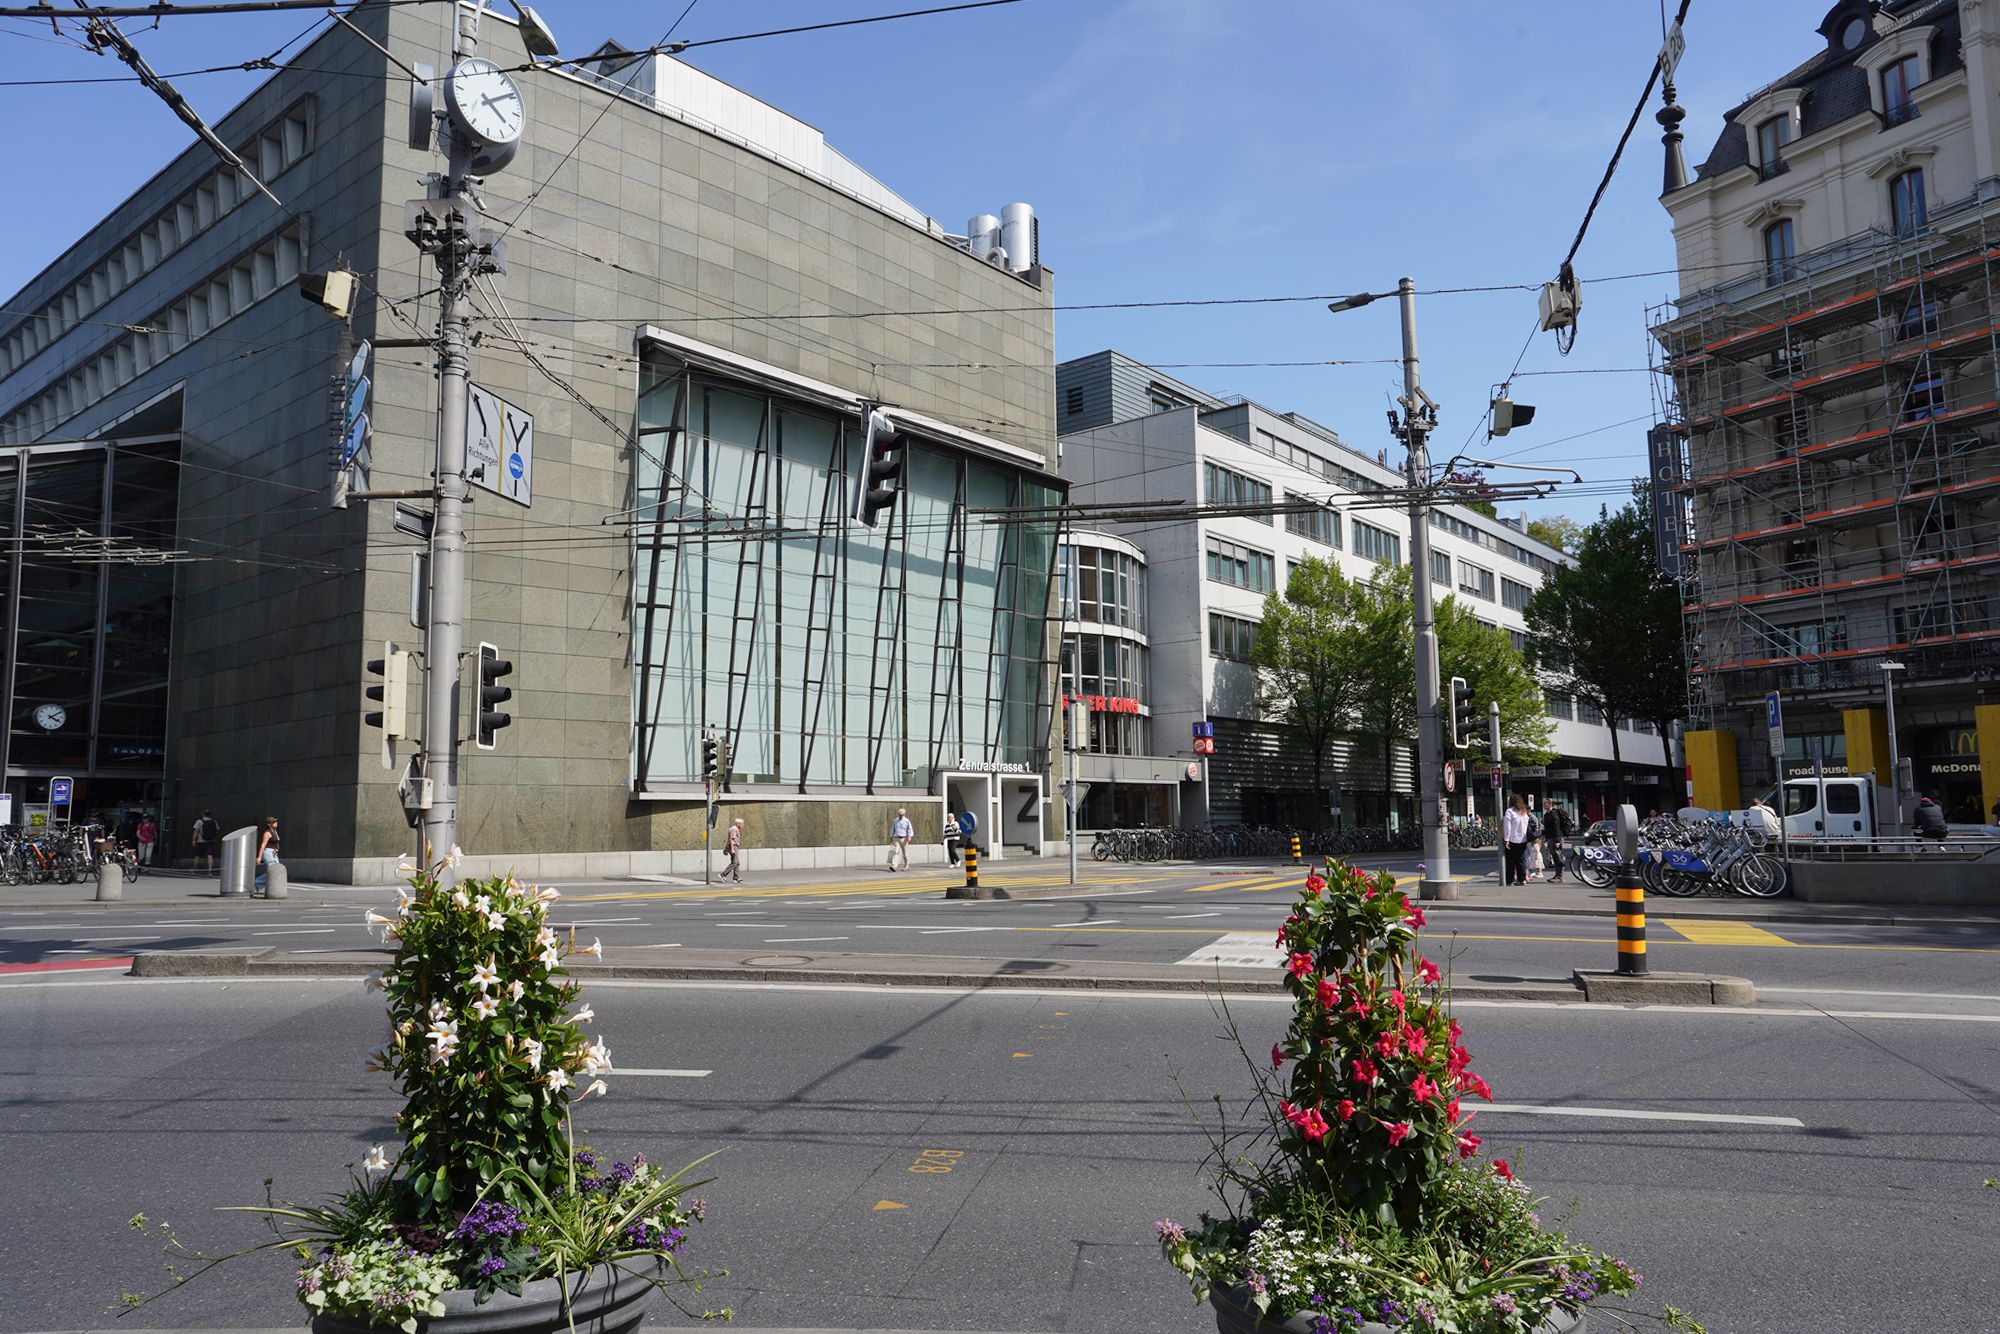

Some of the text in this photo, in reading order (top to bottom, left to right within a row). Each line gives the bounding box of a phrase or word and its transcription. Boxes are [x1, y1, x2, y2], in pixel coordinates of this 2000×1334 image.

[478, 438, 490, 450] Alle
[468, 446, 498, 467] Richtungen
[1656, 442, 1679, 558] HOTEL
[1109, 696, 1139, 713] KING
[959, 759, 1030, 773] Zentralstrasse 1
[1788, 765, 1849, 776] roadouse
[1017, 786, 1040, 822] Z
